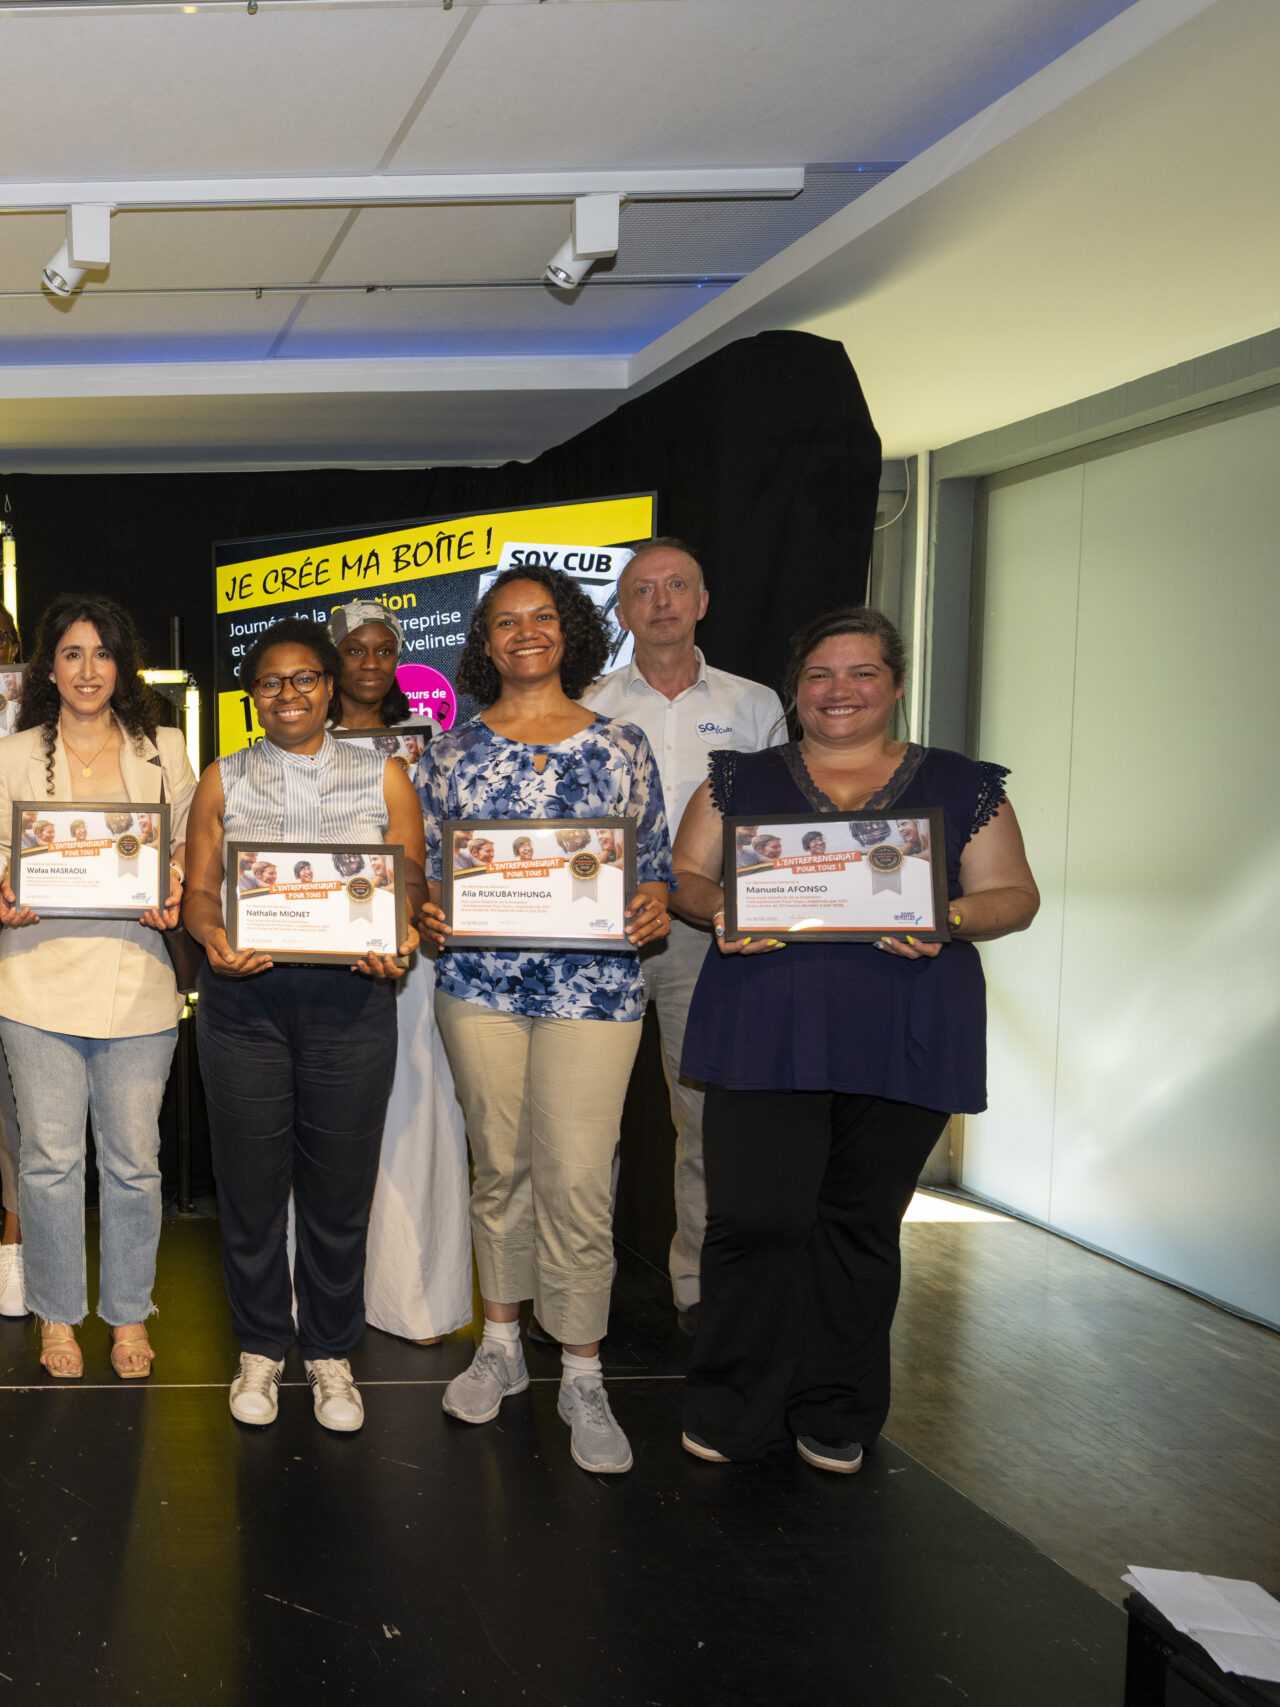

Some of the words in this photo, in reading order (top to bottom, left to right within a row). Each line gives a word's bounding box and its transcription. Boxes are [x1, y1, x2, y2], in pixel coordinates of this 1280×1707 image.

[225, 573, 254, 602] JE
[262, 556, 330, 594] CRÉE
[341, 548, 380, 580] MA
[392, 530, 475, 573] BOÎTE
[485, 526, 493, 555] !
[563, 552, 612, 573] CUB
[312, 609, 327, 623] la
[231, 643, 246, 657] et
[431, 688, 447, 699] de
[776, 851, 857, 867] L'ENTREPRENEURIAT
[50, 867, 87, 875] NASRAOUI
[796, 865, 816, 873] POUR
[478, 890, 552, 898] RUKUBAYIHUNGA
[787, 885, 828, 893] AFONSO
[246, 909, 278, 917] Nathalie
[280, 910, 310, 918] MIONET
